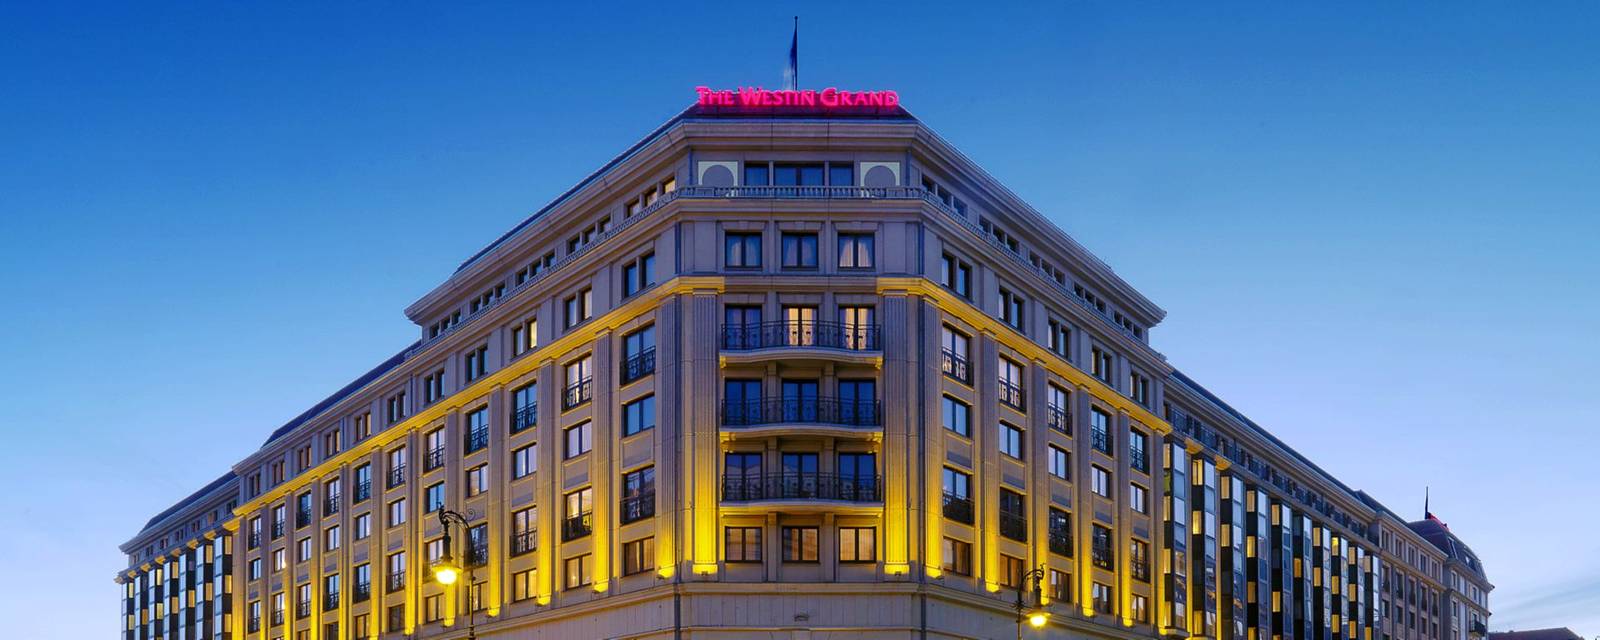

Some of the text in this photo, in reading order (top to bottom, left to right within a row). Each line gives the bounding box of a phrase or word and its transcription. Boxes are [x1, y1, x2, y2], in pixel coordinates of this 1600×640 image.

[696, 86, 899, 107] THE WESTIN GRAND
